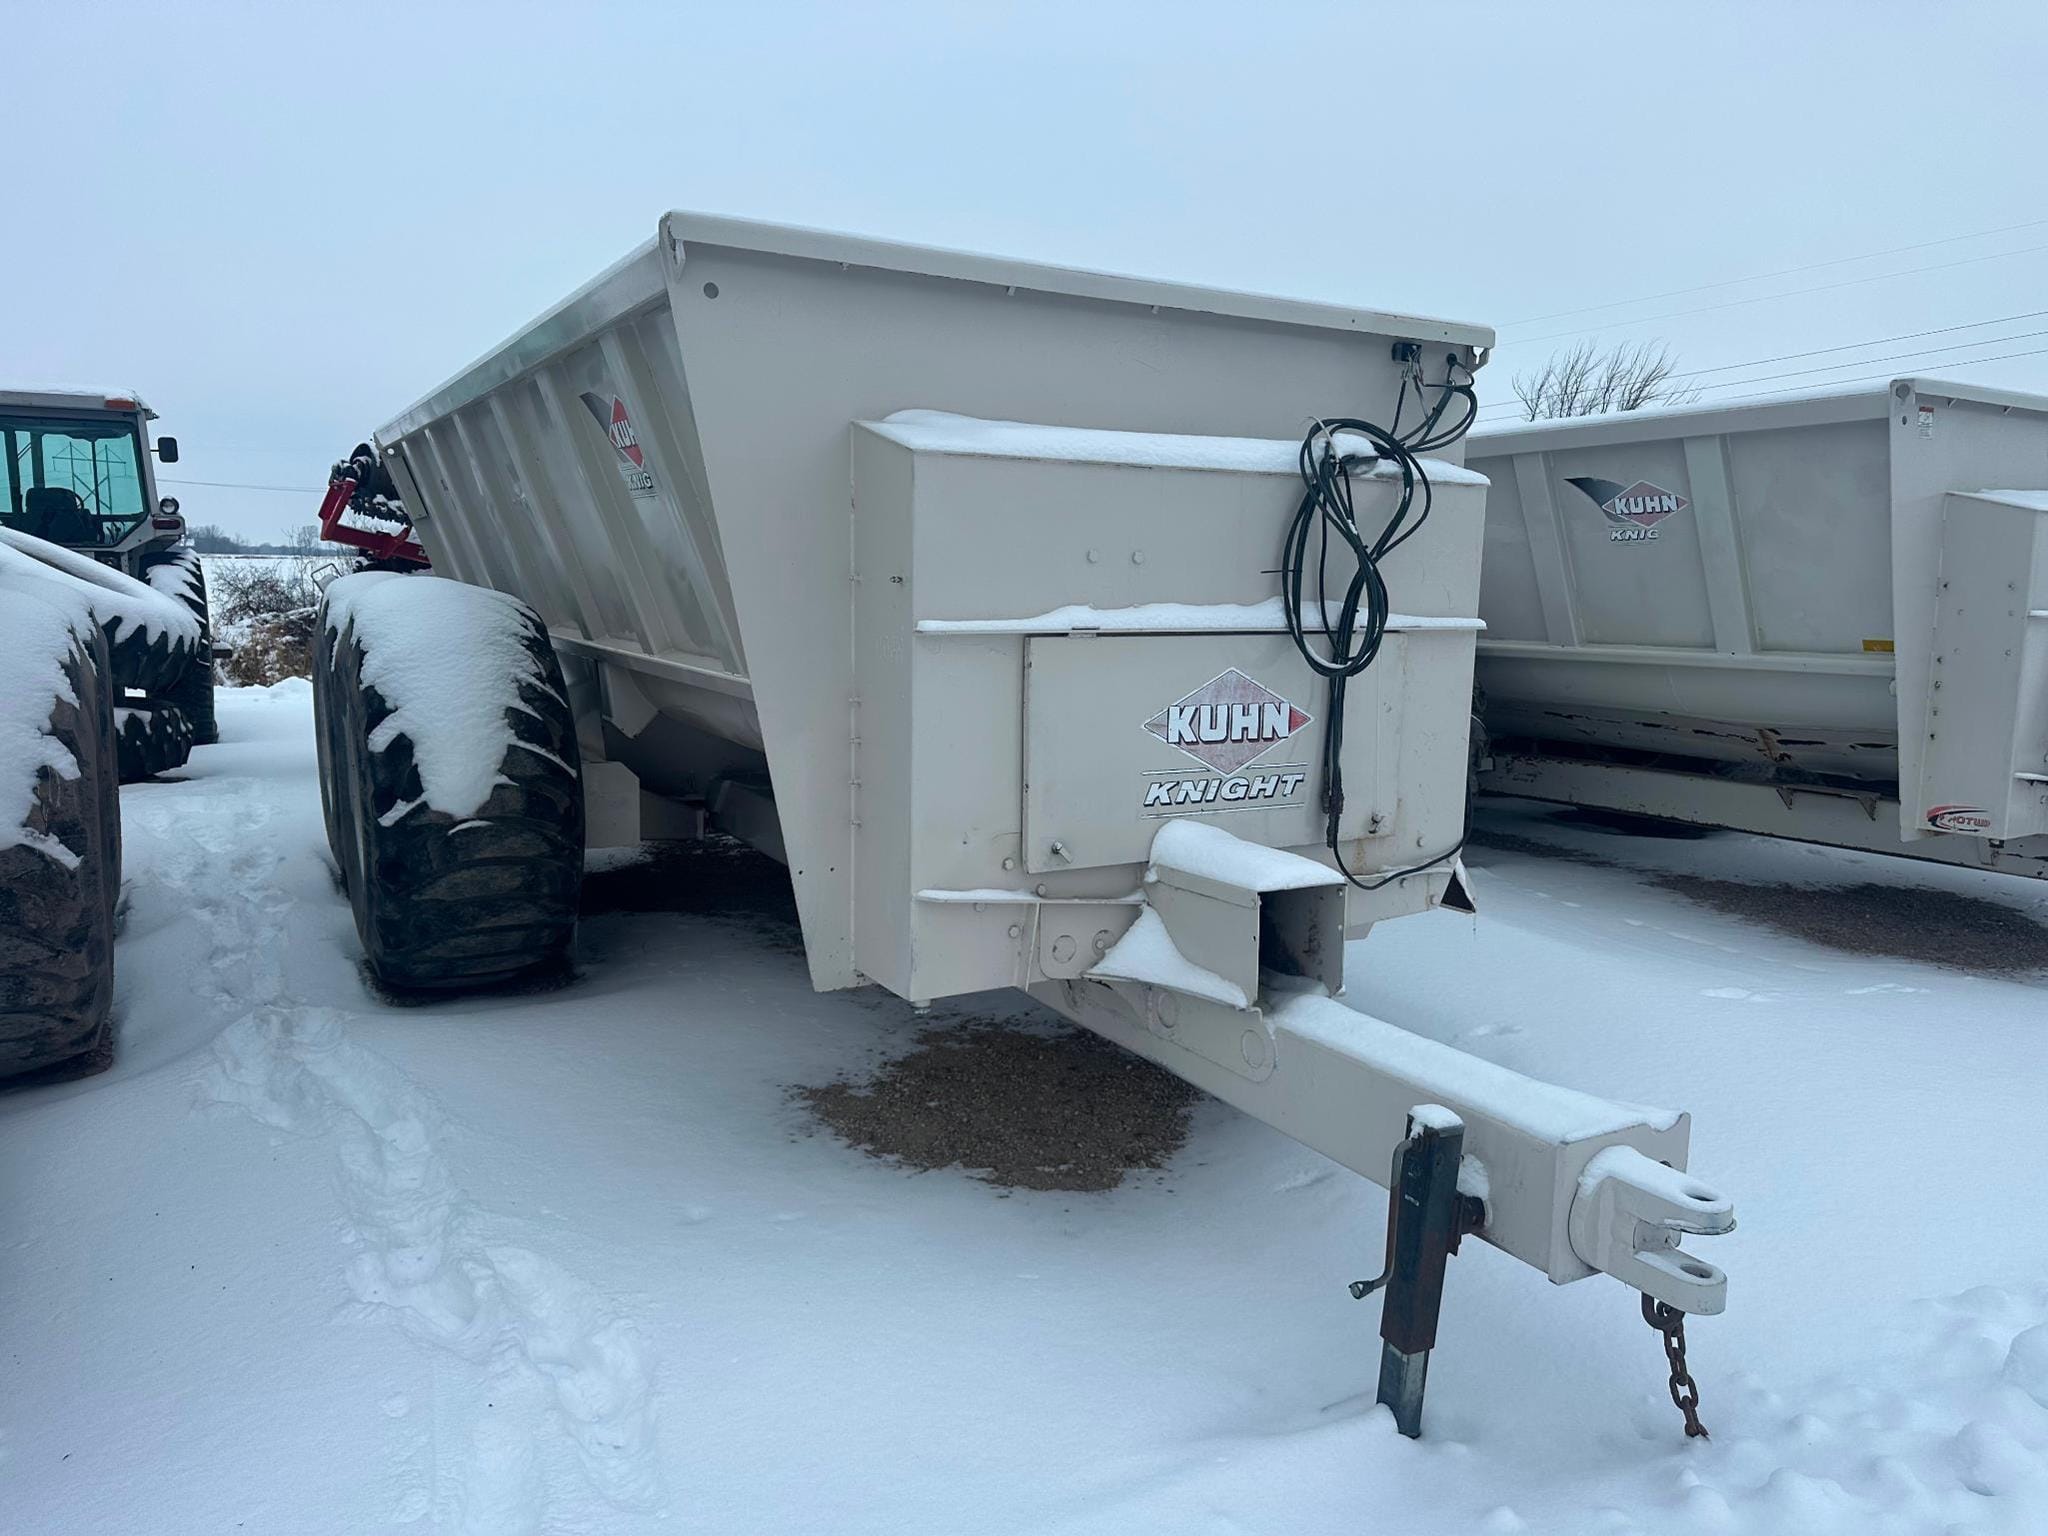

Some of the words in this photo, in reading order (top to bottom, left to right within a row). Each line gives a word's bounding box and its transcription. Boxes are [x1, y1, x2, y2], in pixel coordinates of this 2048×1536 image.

[1614, 494, 1679, 515] KUHN
[1167, 702, 1291, 745] KUHN
[1143, 773, 1305, 807] KNIGHT
